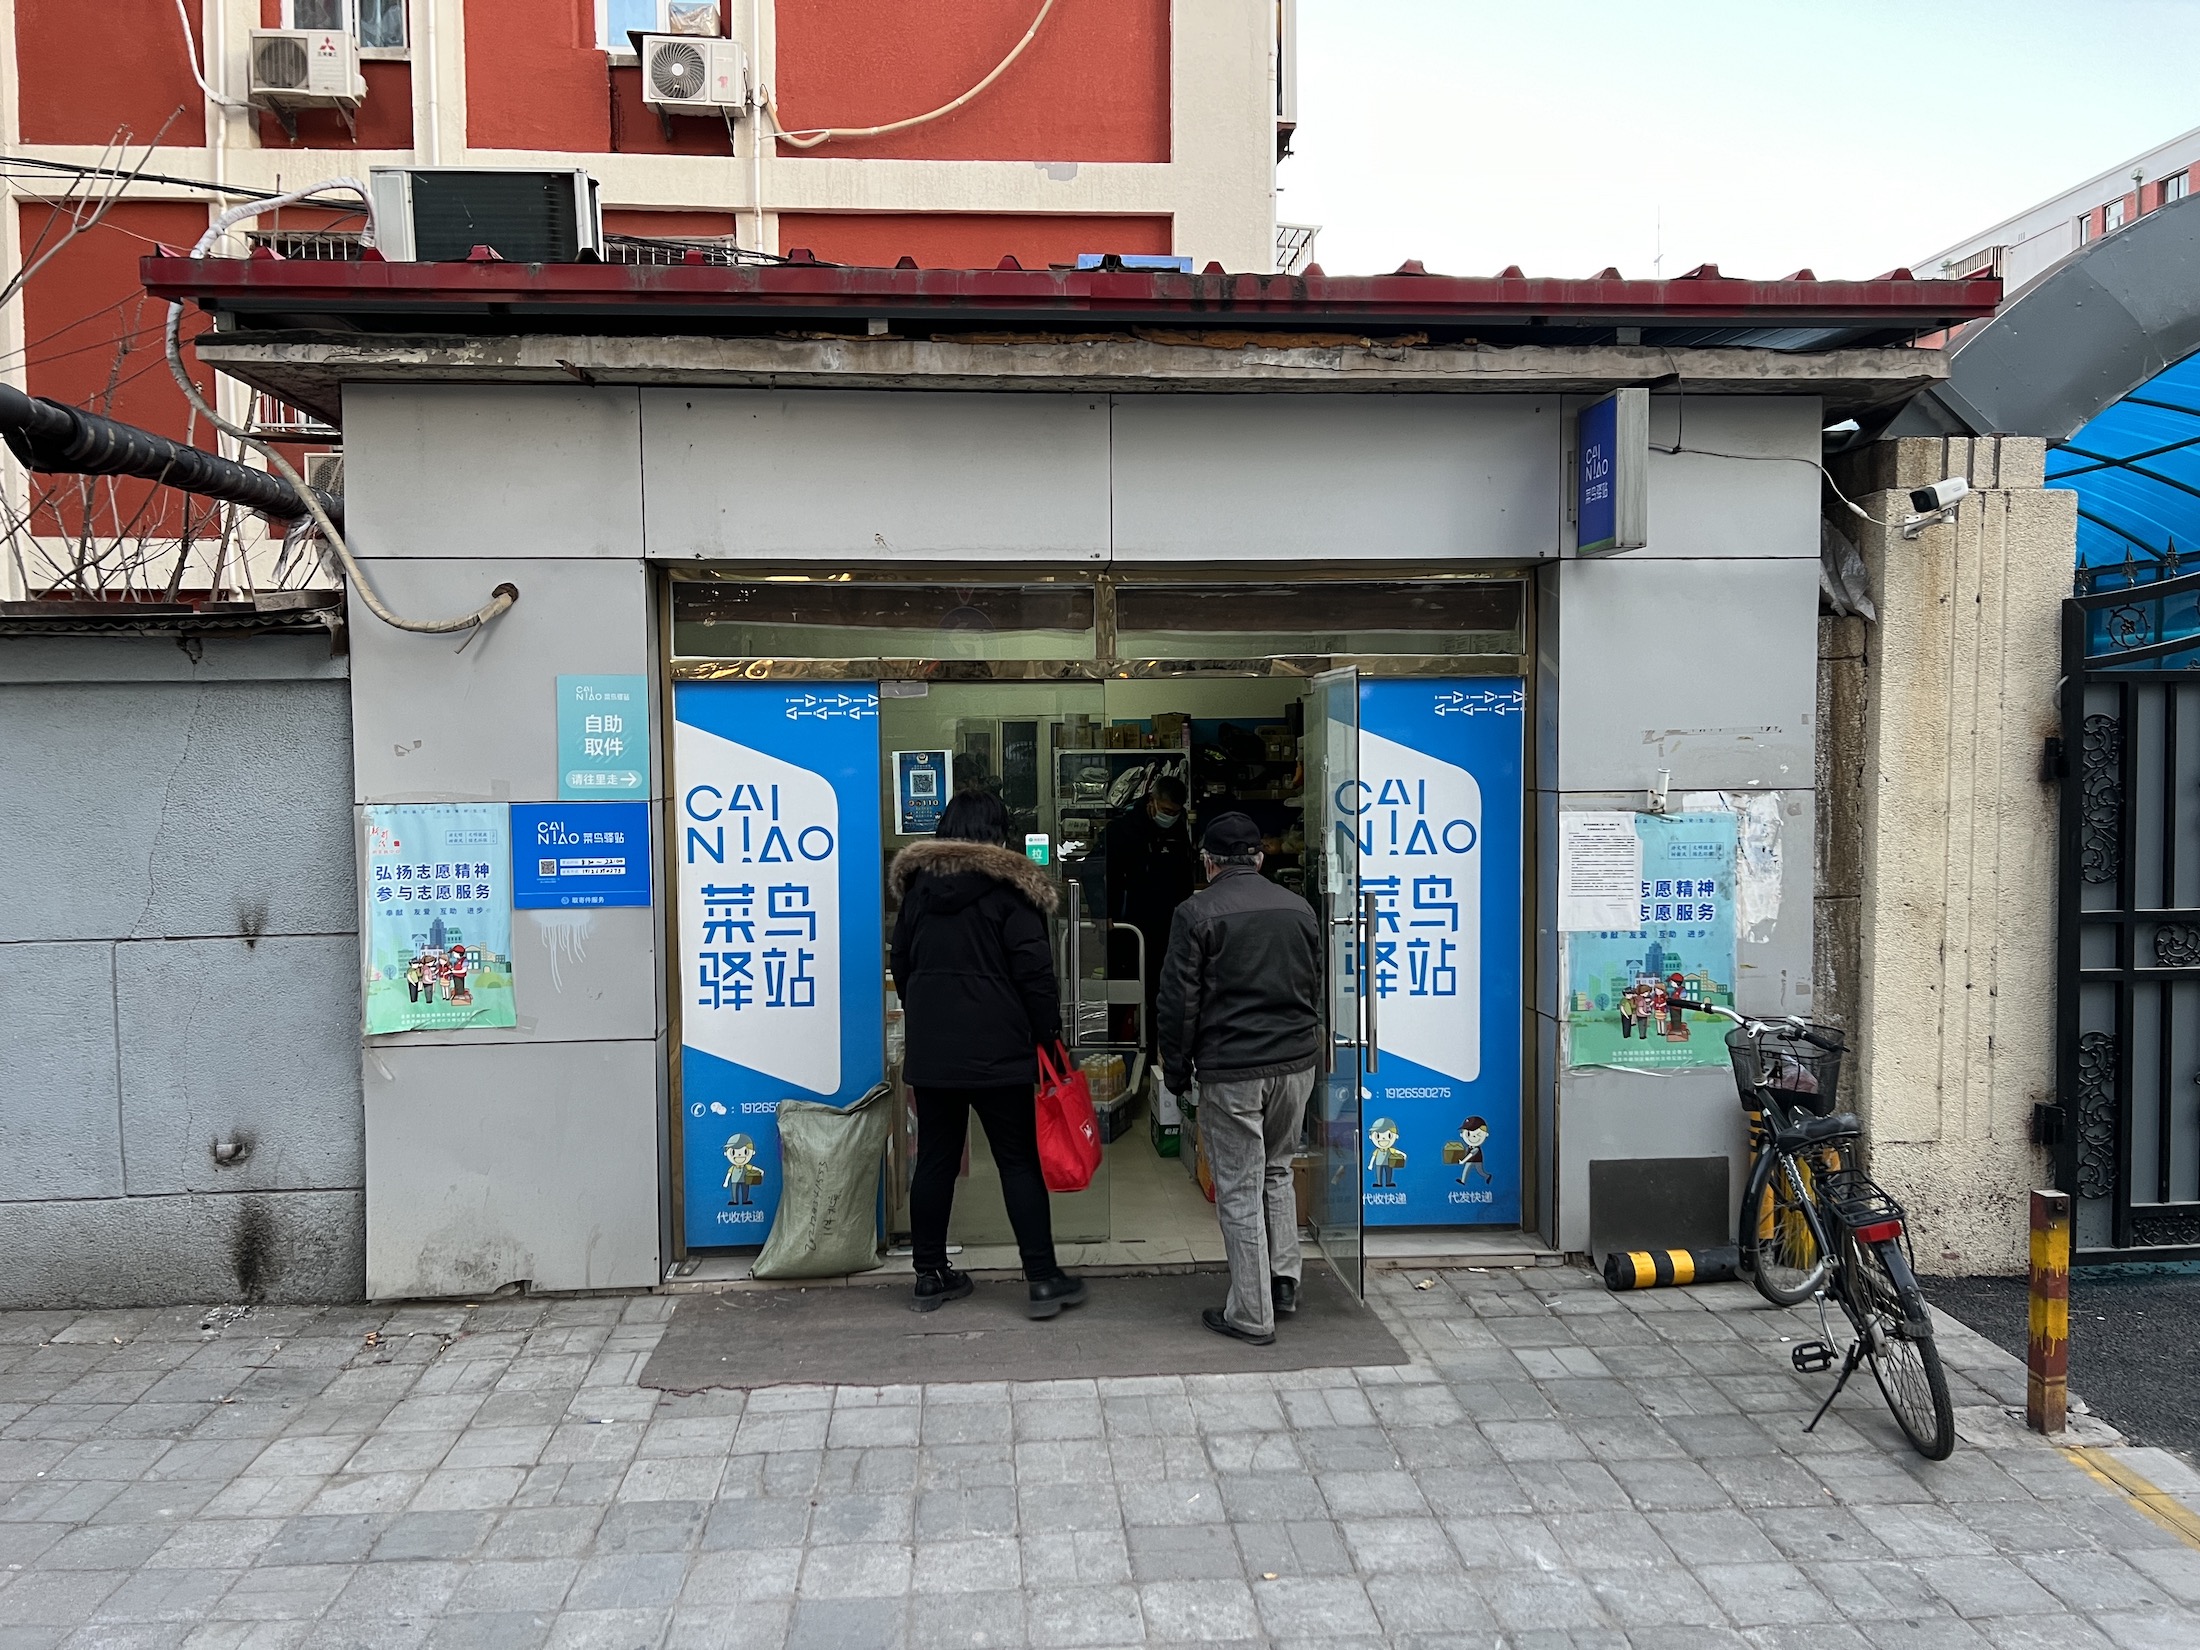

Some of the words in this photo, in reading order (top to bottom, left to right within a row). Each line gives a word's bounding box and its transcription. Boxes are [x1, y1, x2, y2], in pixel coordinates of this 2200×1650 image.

[1586, 444, 1601, 465] CAI
[585, 714, 622, 733] 自助
[584, 738, 623, 756] 取件
[571, 774, 618, 785] 请往里走
[686, 784, 778, 821] CAI
[1335, 779, 1425, 816] CAI
[538, 821, 564, 833] CAI
[538, 831, 579, 845] NIAO
[583, 832, 624, 844] 菜鸟驿站
[687, 816, 834, 864] NIAO
[1032, 849, 1043, 859] 拉
[376, 864, 490, 881] 弘扬志愿精神
[376, 885, 491, 902] 参与志愿服务
[701, 882, 816, 944] 菜鸟
[1600, 930, 1618, 939] 奉献
[1629, 930, 1647, 939] 友爱
[1658, 930, 1677, 938] 互助
[1688, 930, 1706, 938] 进步
[698, 947, 815, 1011] 驿站
[1385, 1087, 1451, 1099] 19126590275
[1362, 1192, 1407, 1205] 代收快递
[1447, 1191, 1493, 1204] 代发快递
[716, 1210, 764, 1224] 代收快递
